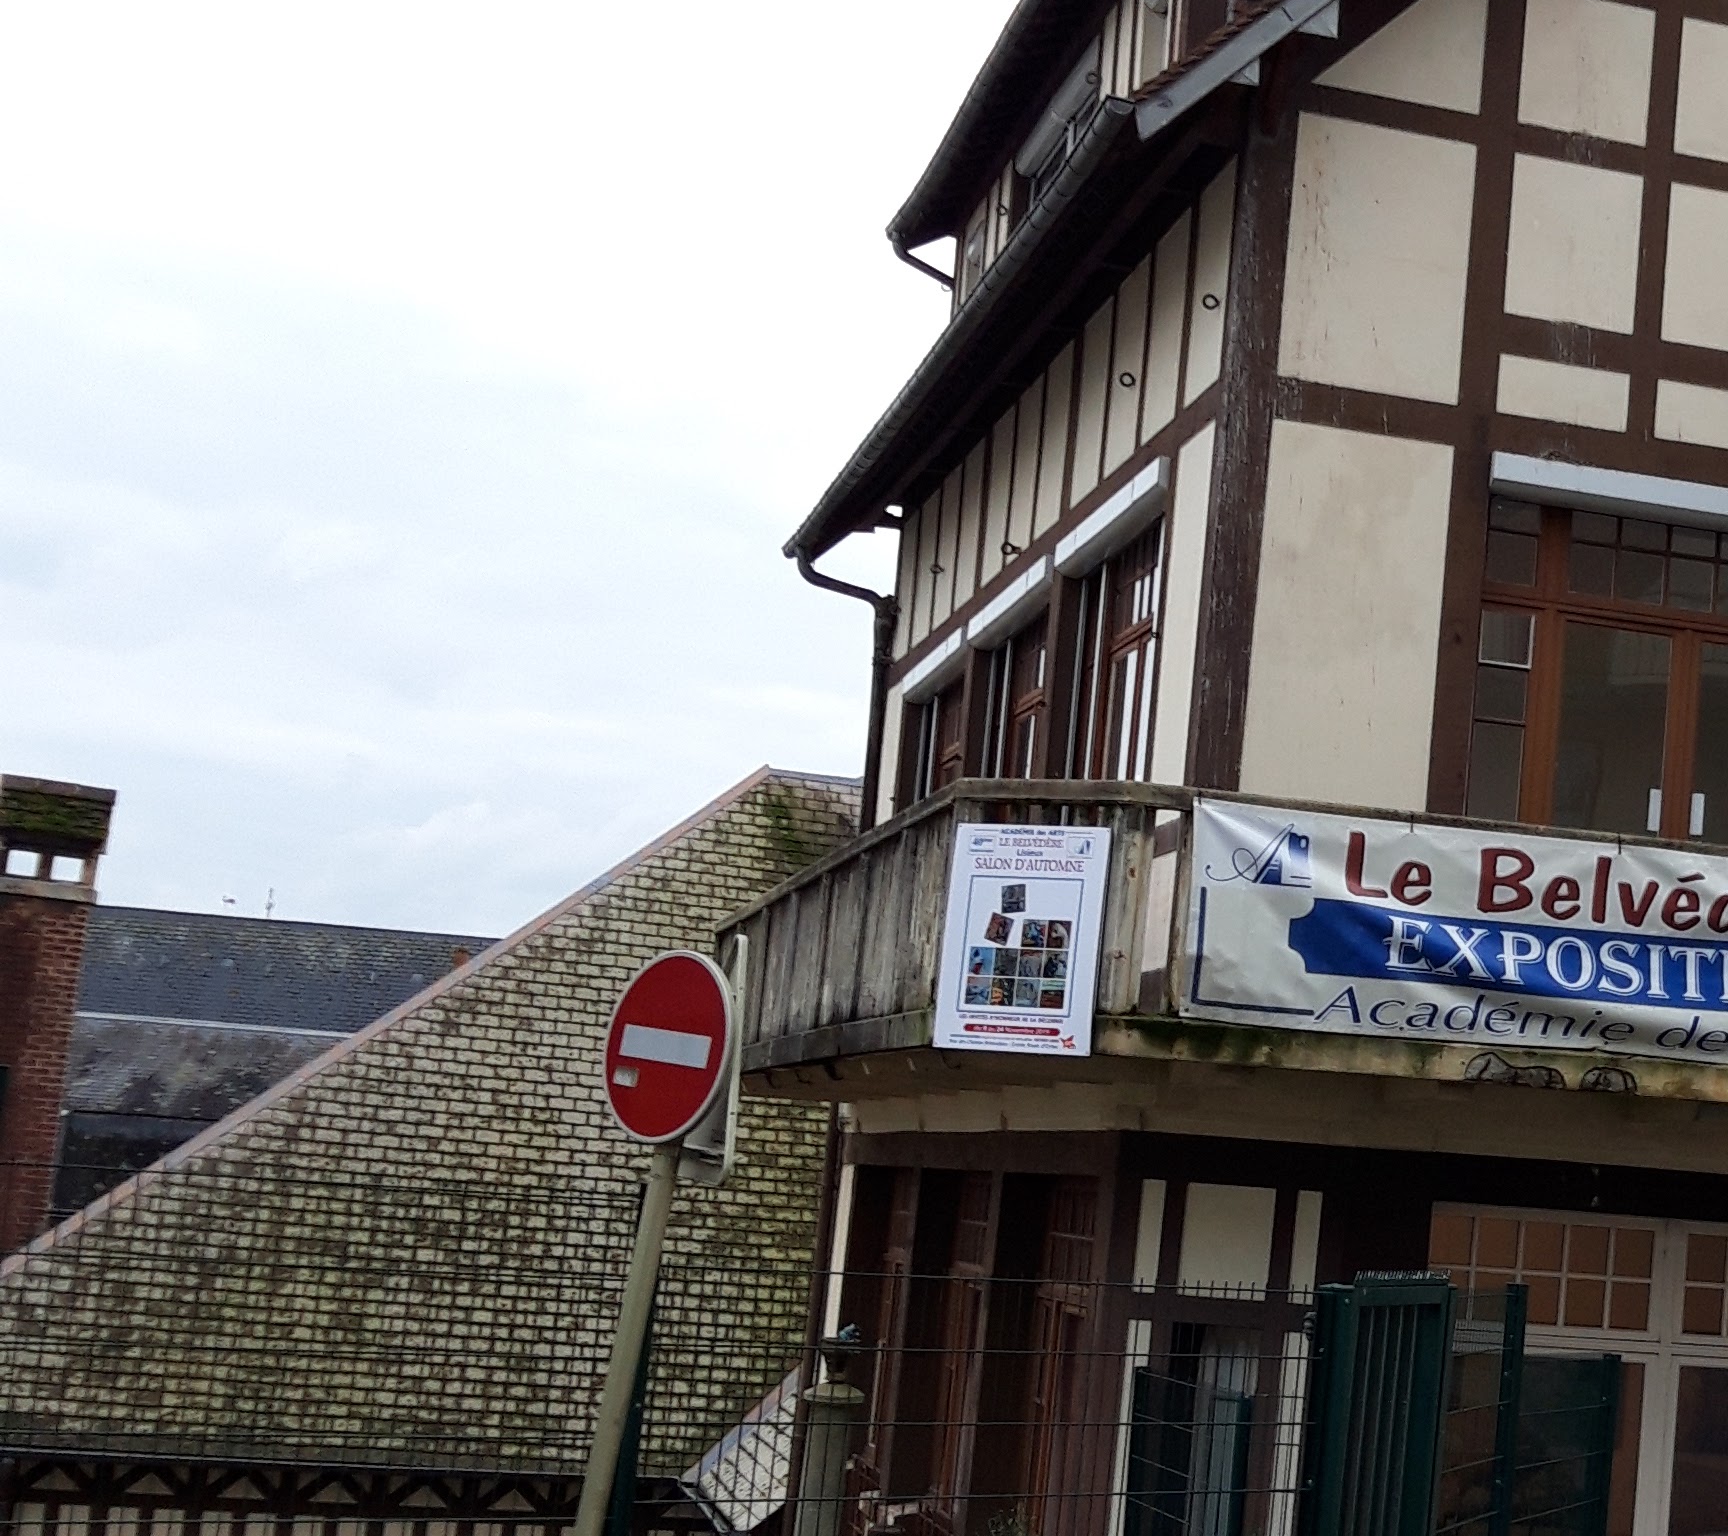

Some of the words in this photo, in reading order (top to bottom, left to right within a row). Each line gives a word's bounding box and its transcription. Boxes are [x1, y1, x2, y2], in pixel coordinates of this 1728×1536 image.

[999, 837, 1011, 846] LE
[975, 857, 1012, 870] SALON
[1015, 858, 1084, 872] D'AUTOMNE
[1343, 831, 1433, 906] Le
[1312, 984, 1635, 1044] Académie
